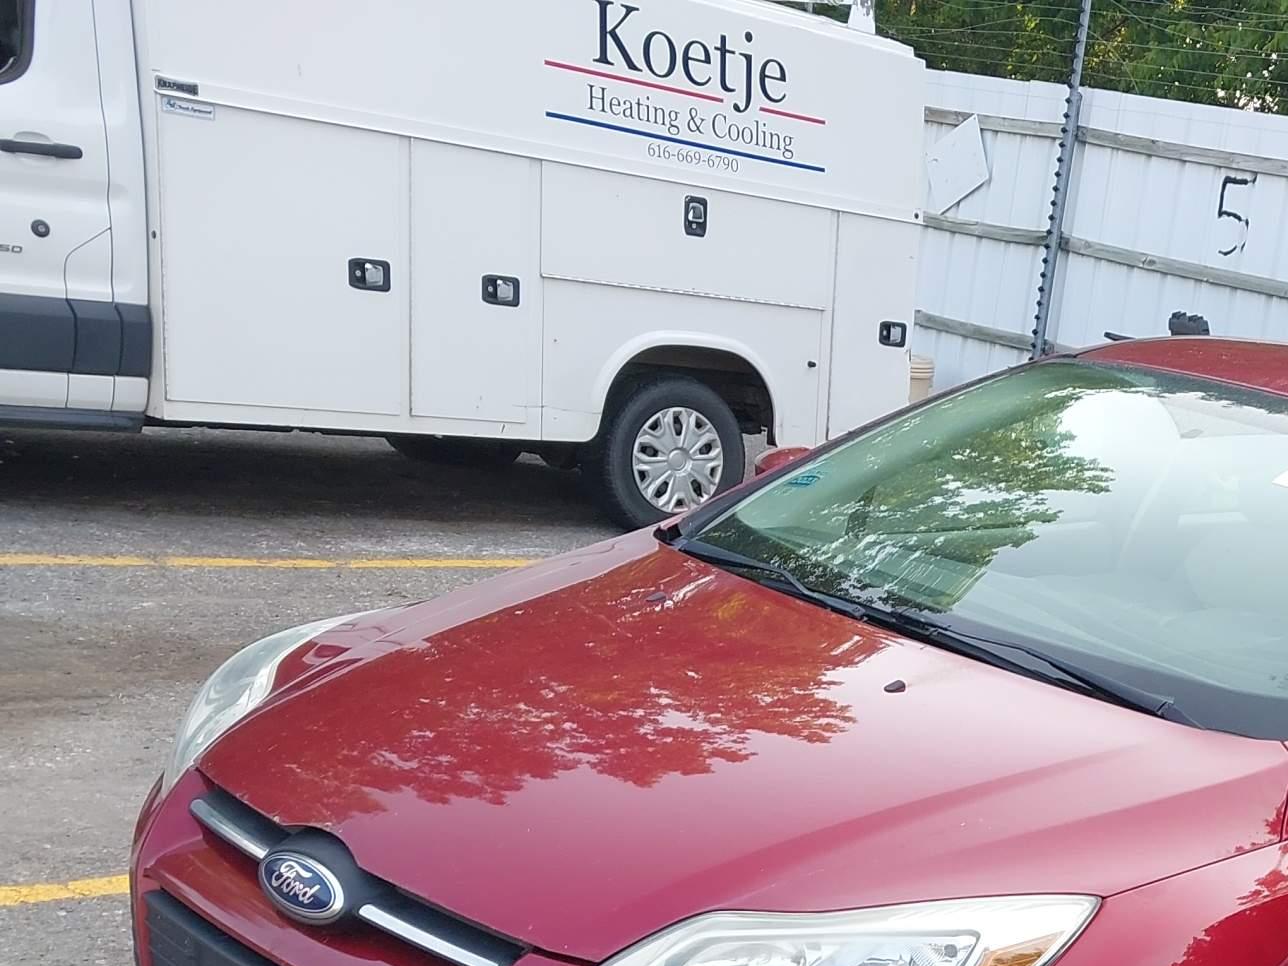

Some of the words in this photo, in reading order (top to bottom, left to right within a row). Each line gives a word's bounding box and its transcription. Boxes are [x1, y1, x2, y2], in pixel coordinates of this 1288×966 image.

[592, 0, 787, 113] Koetje
[586, 83, 680, 136] Heating
[687, 107, 705, 136] &
[711, 112, 794, 160] Cooling
[647, 142, 739, 173] 616-669-6790
[1218, 175, 1255, 256] 5
[271, 861, 321, 905] Ford
